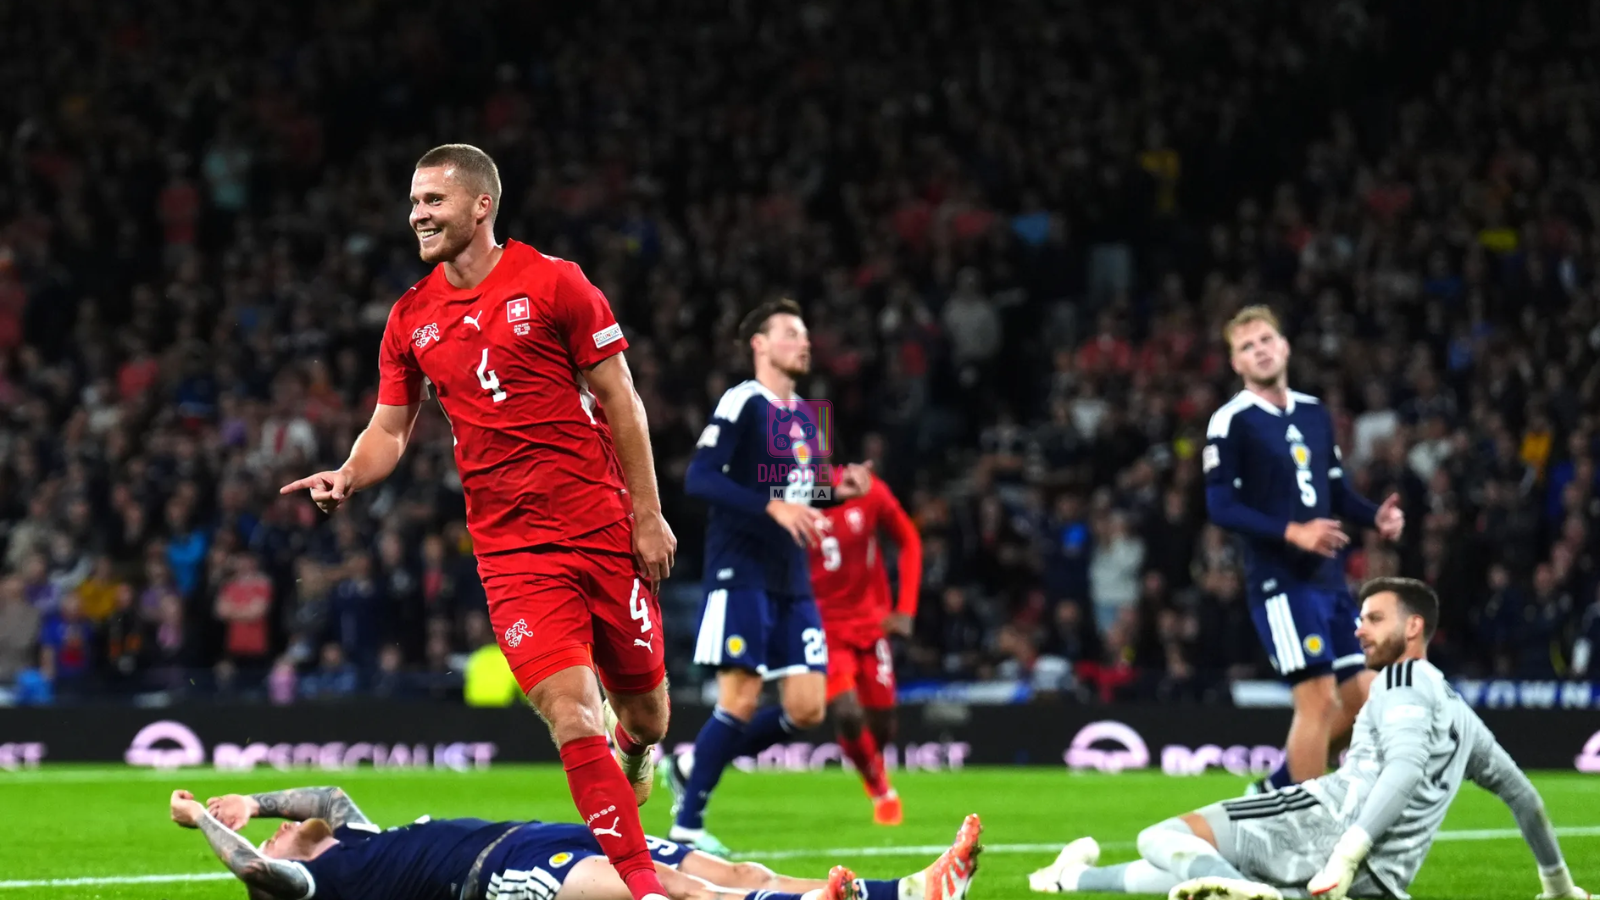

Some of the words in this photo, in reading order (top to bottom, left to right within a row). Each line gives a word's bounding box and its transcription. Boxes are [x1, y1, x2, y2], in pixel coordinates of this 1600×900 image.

[477, 348, 507, 403] 4
[1296, 469, 1317, 508] 5
[630, 578, 652, 634] 4
[801, 627, 829, 665] 2
